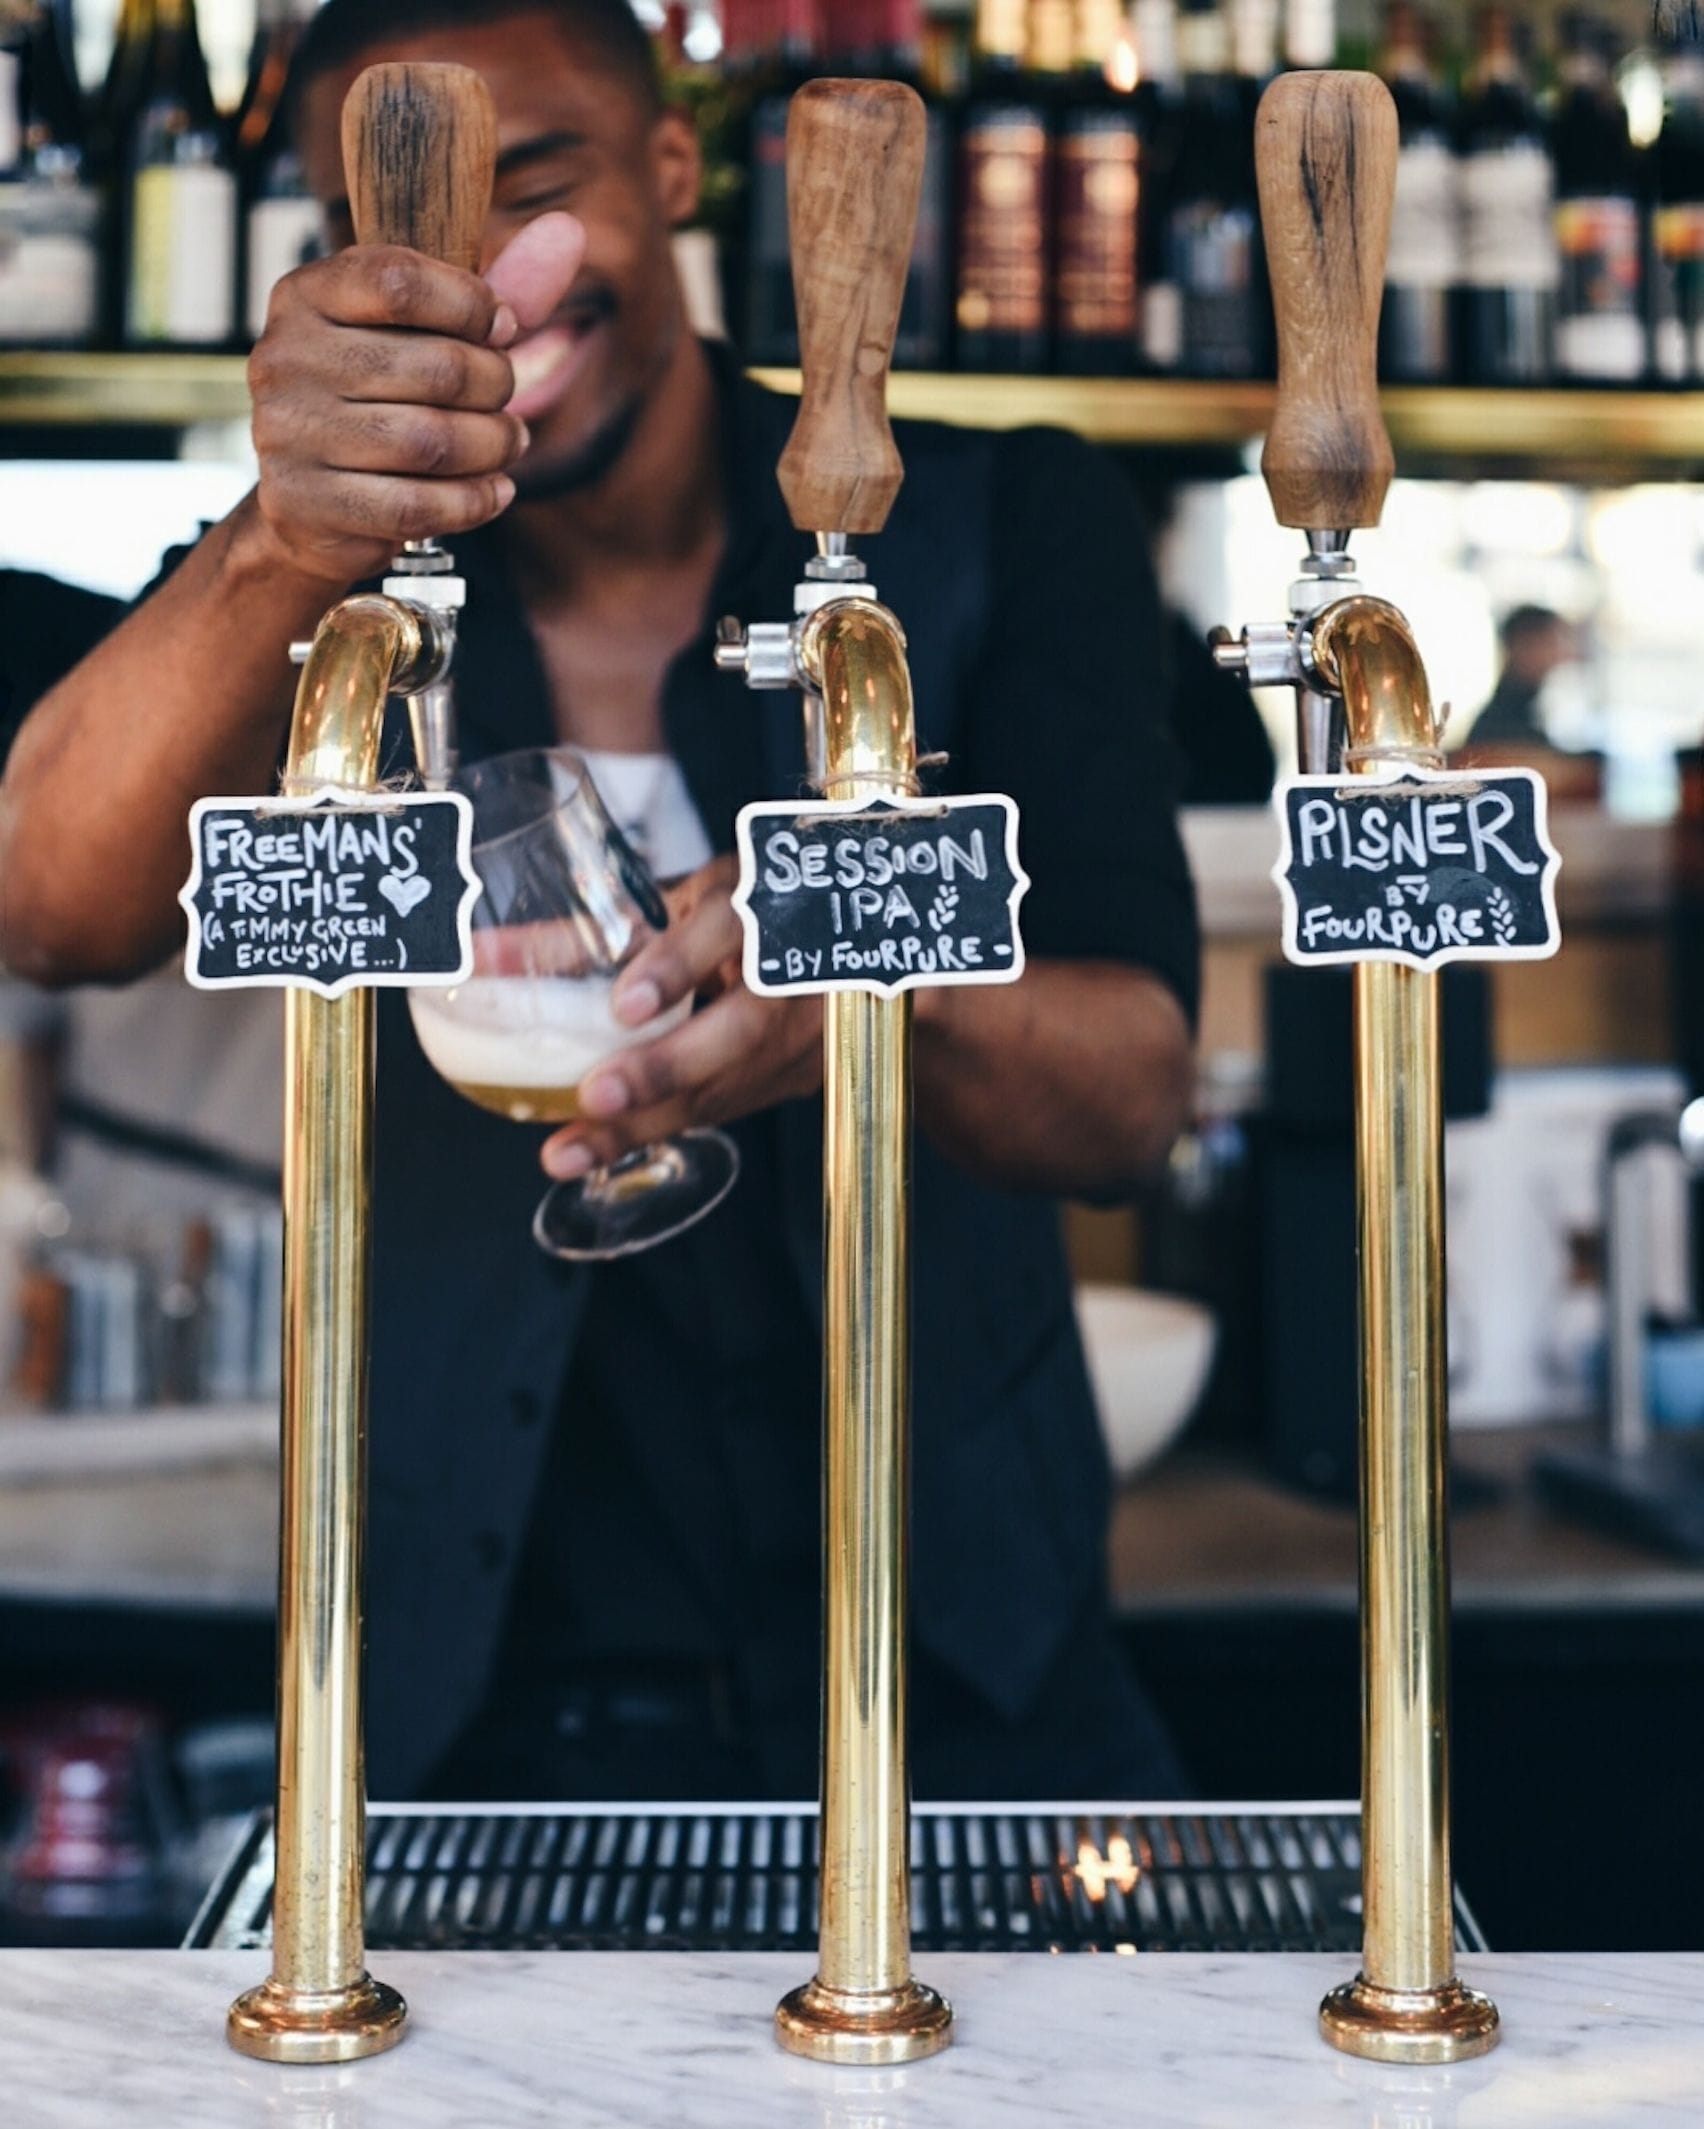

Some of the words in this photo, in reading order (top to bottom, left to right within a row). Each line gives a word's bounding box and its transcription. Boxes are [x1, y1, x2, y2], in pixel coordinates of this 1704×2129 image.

[205, 814, 421, 878] FREEMANS'
[1299, 790, 1539, 874] PILSNER
[764, 828, 988, 893] SESSION
[211, 869, 368, 917] FROTHIE
[831, 884, 920, 934] IPA
[1385, 876, 1430, 907] BY
[312, 915, 387, 943] GREEN
[1302, 904, 1483, 950] FOURPURE
[832, 934, 983, 972] FOURPURE
